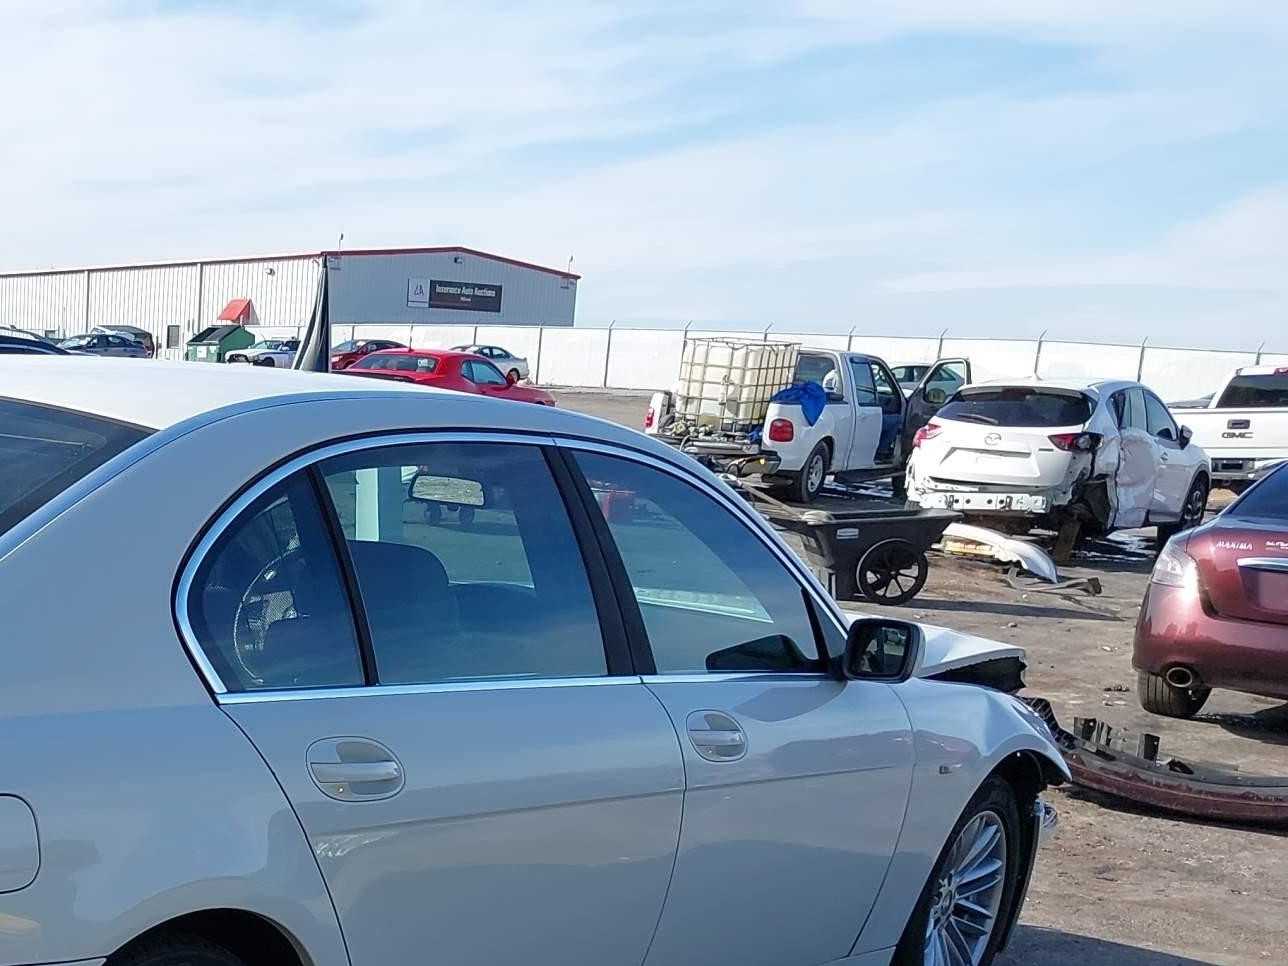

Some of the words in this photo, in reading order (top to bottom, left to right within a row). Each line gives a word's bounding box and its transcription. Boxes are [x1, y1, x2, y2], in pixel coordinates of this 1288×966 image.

[436, 283, 461, 294] Insurance
[462, 286, 473, 295] Auto
[474, 287, 496, 297] Auctions
[1216, 540, 1253, 551] MAXIMA
